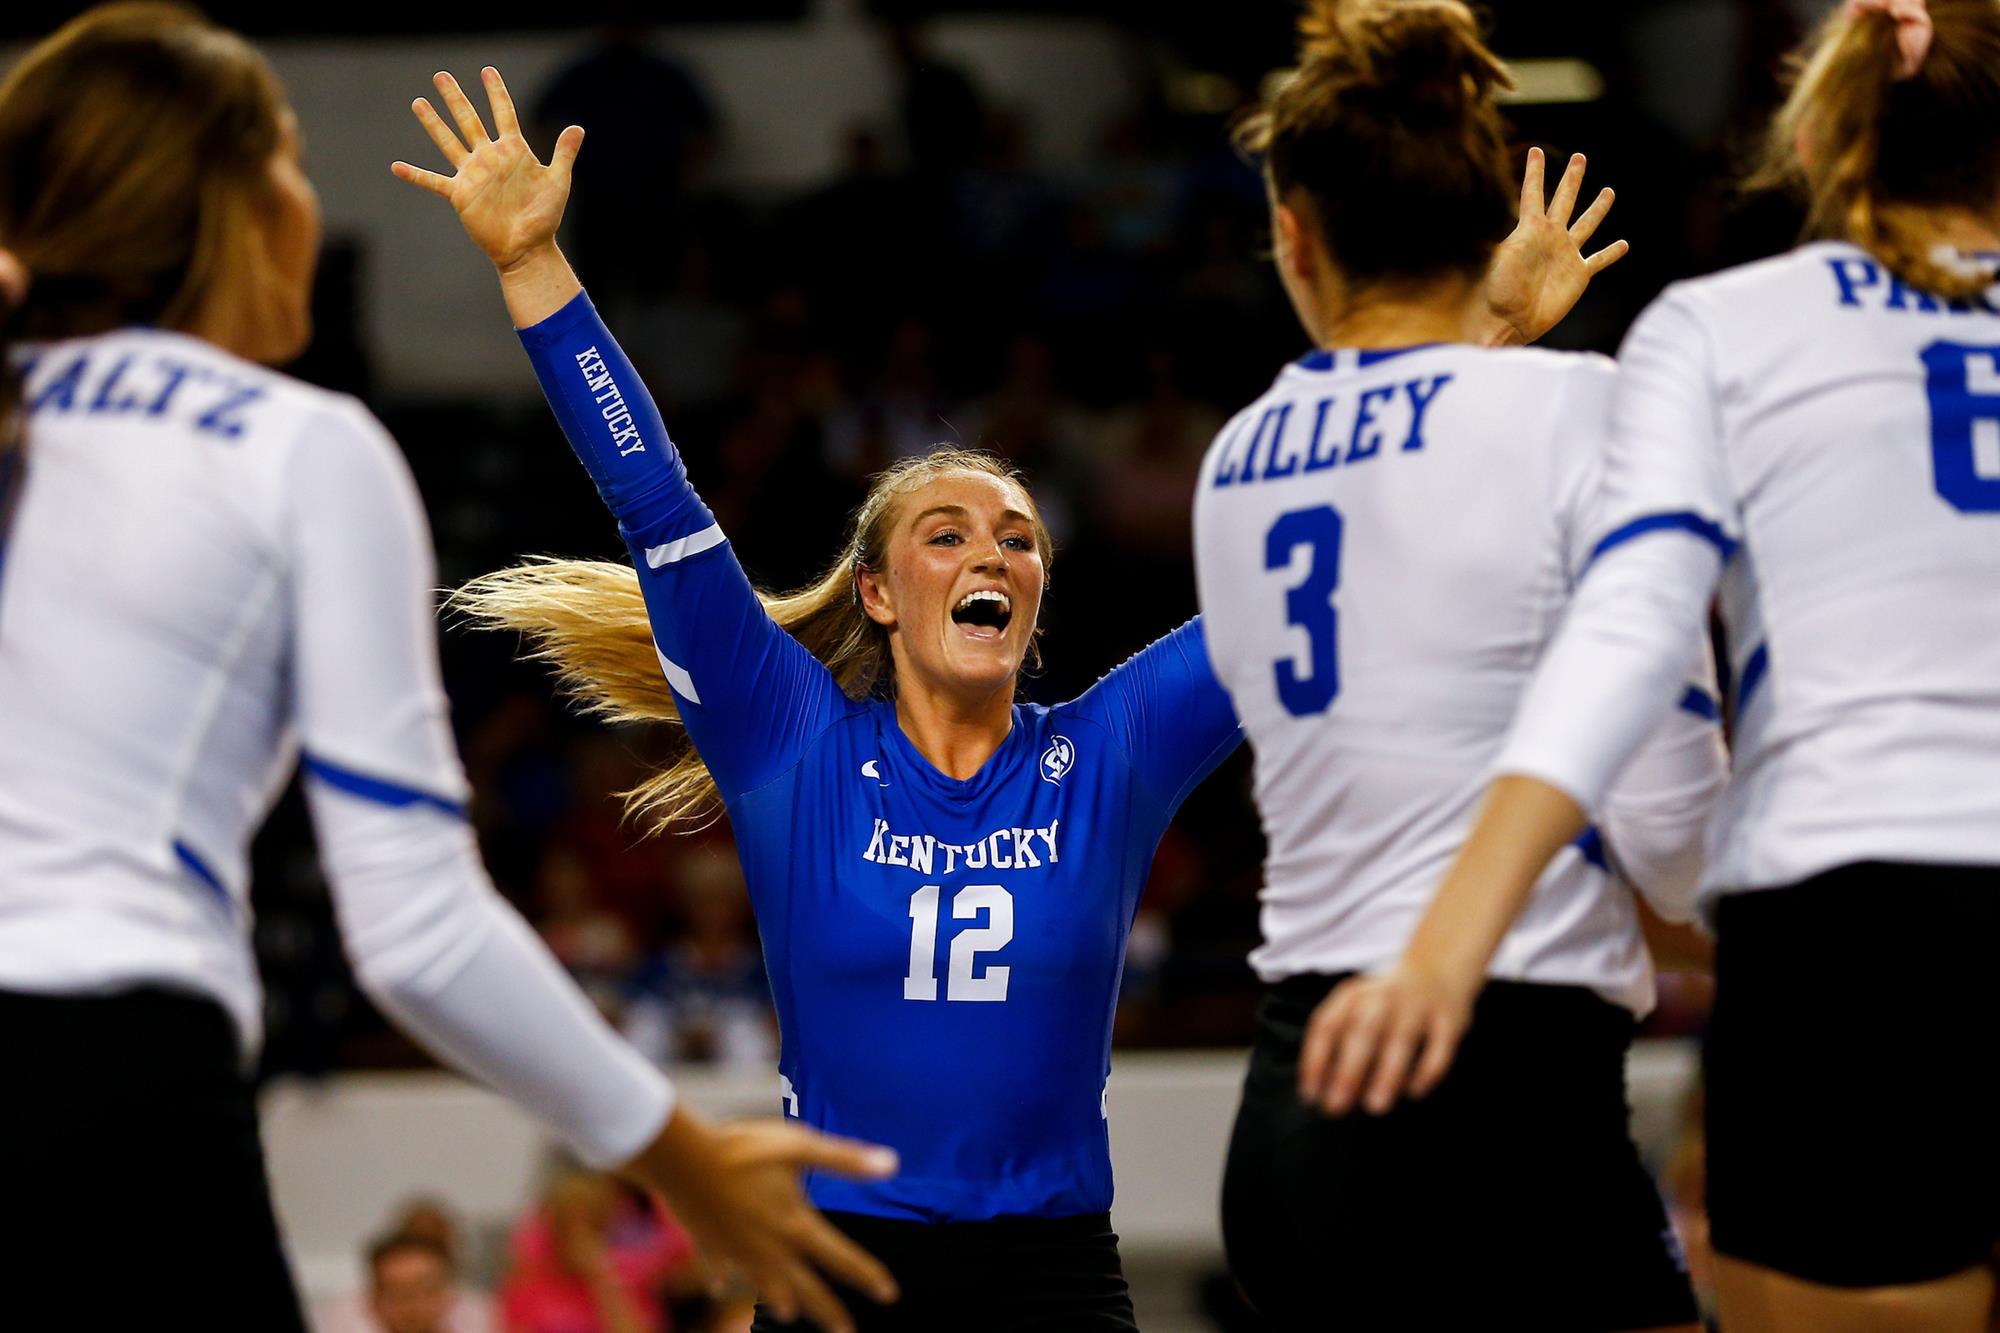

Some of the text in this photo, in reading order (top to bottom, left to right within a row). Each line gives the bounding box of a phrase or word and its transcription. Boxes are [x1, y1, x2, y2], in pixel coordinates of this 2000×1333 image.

[20, 352, 267, 439] ALTZ
[576, 346, 645, 457] KENTUCKY
[1213, 372, 1455, 489] LILLEY
[1264, 501, 1344, 719] 3
[863, 818, 1059, 875] KENTUCKY
[904, 884, 1014, 1002] 12
